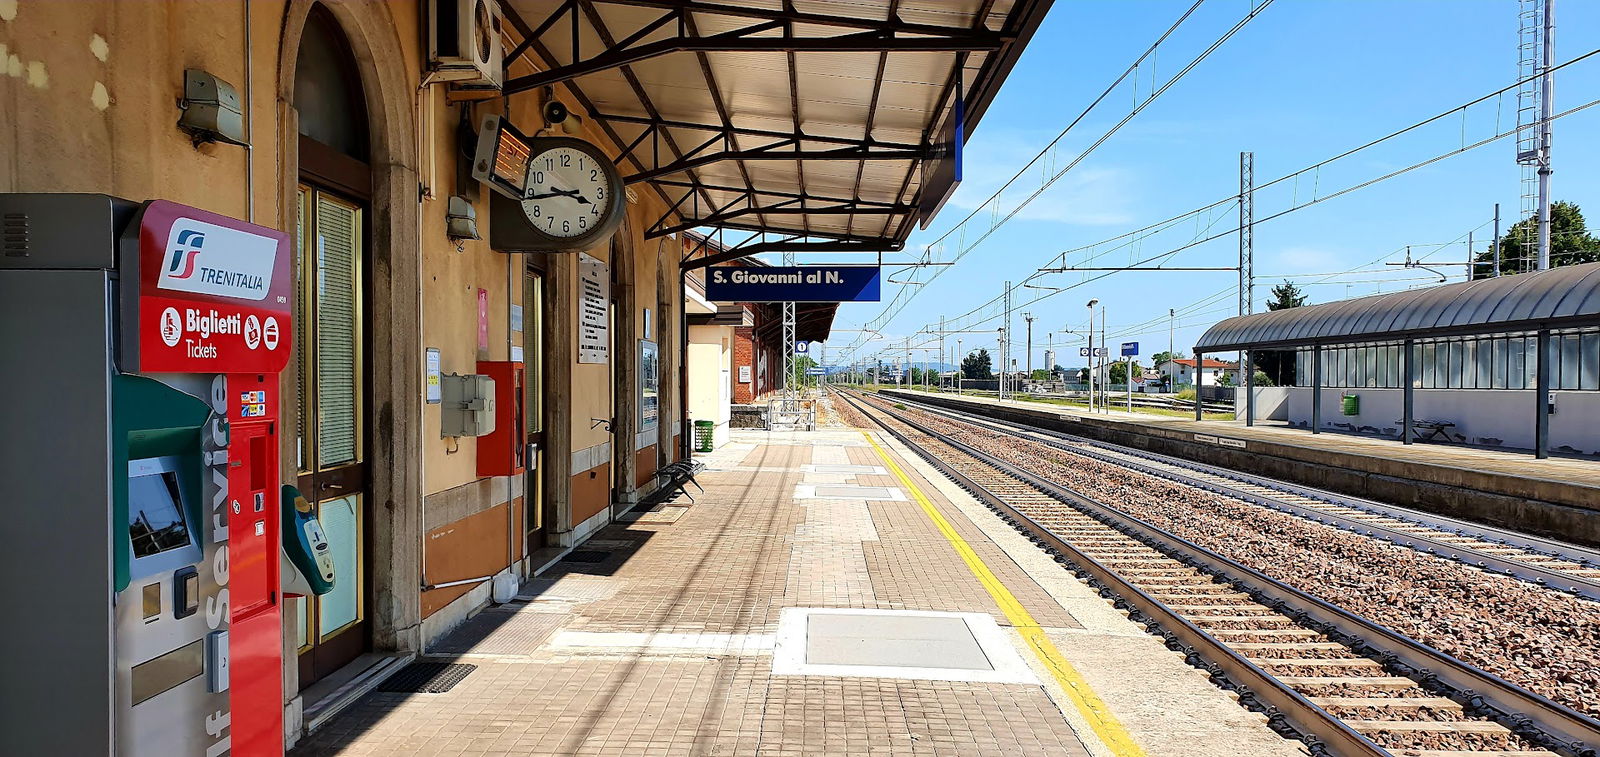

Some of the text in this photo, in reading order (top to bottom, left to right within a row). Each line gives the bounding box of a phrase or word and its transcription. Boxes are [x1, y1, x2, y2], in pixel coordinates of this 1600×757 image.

[546, 159, 554, 171] 11
[560, 154, 570, 167] 12
[579, 158, 583, 171] 1
[533, 171, 544, 184] 10
[591, 170, 597, 181] 2
[528, 188, 535, 200] 9
[597, 187, 604, 200] 3
[533, 205, 541, 217] 8
[591, 204, 598, 216] 4
[547, 216, 554, 228] 7
[563, 221, 569, 233] 6
[579, 216, 586, 228] 5
[201, 267, 263, 290] TRENITALIA
[713, 270, 844, 284] S. Giovanni al N.
[186, 309, 240, 338] Biglietti
[185, 339, 217, 358] Tickets
[204, 374, 230, 630] Service
